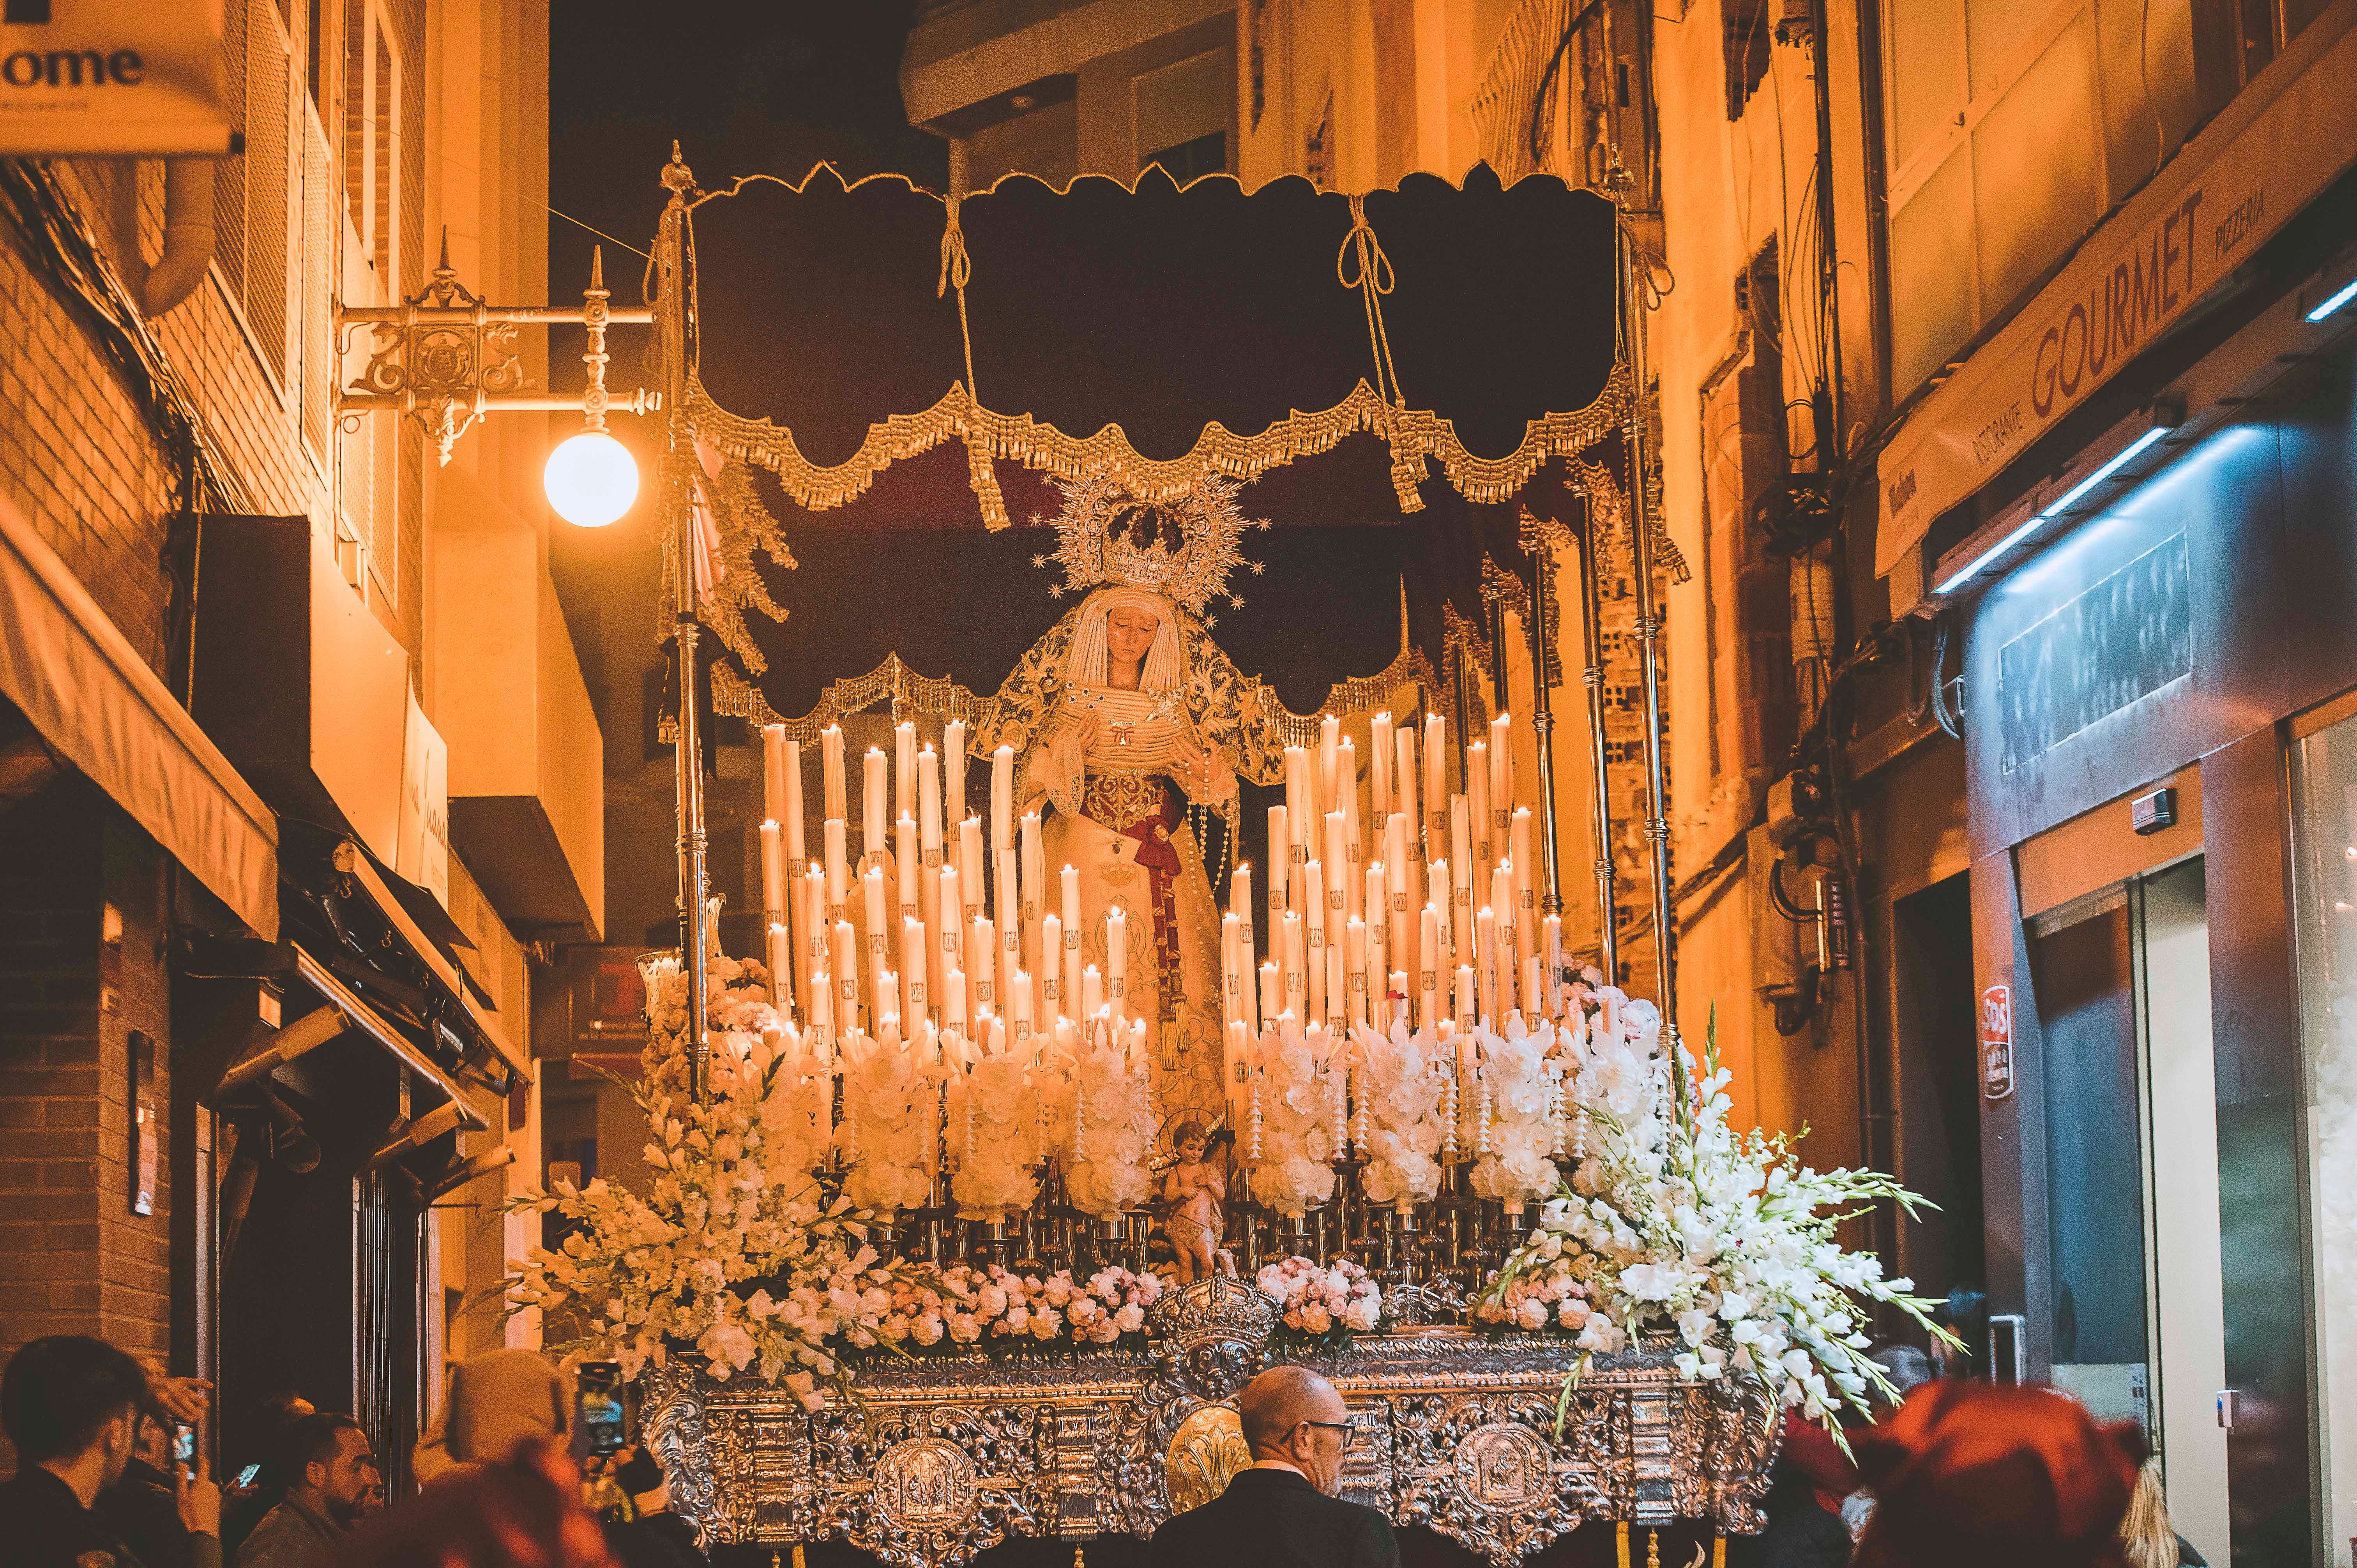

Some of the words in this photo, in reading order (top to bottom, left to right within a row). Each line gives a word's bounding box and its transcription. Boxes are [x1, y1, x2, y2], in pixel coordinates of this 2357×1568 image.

[2, 49, 144, 87] ome
[2032, 188, 2203, 418] GOURMET
[2215, 187, 2264, 261] PIZZERIA
